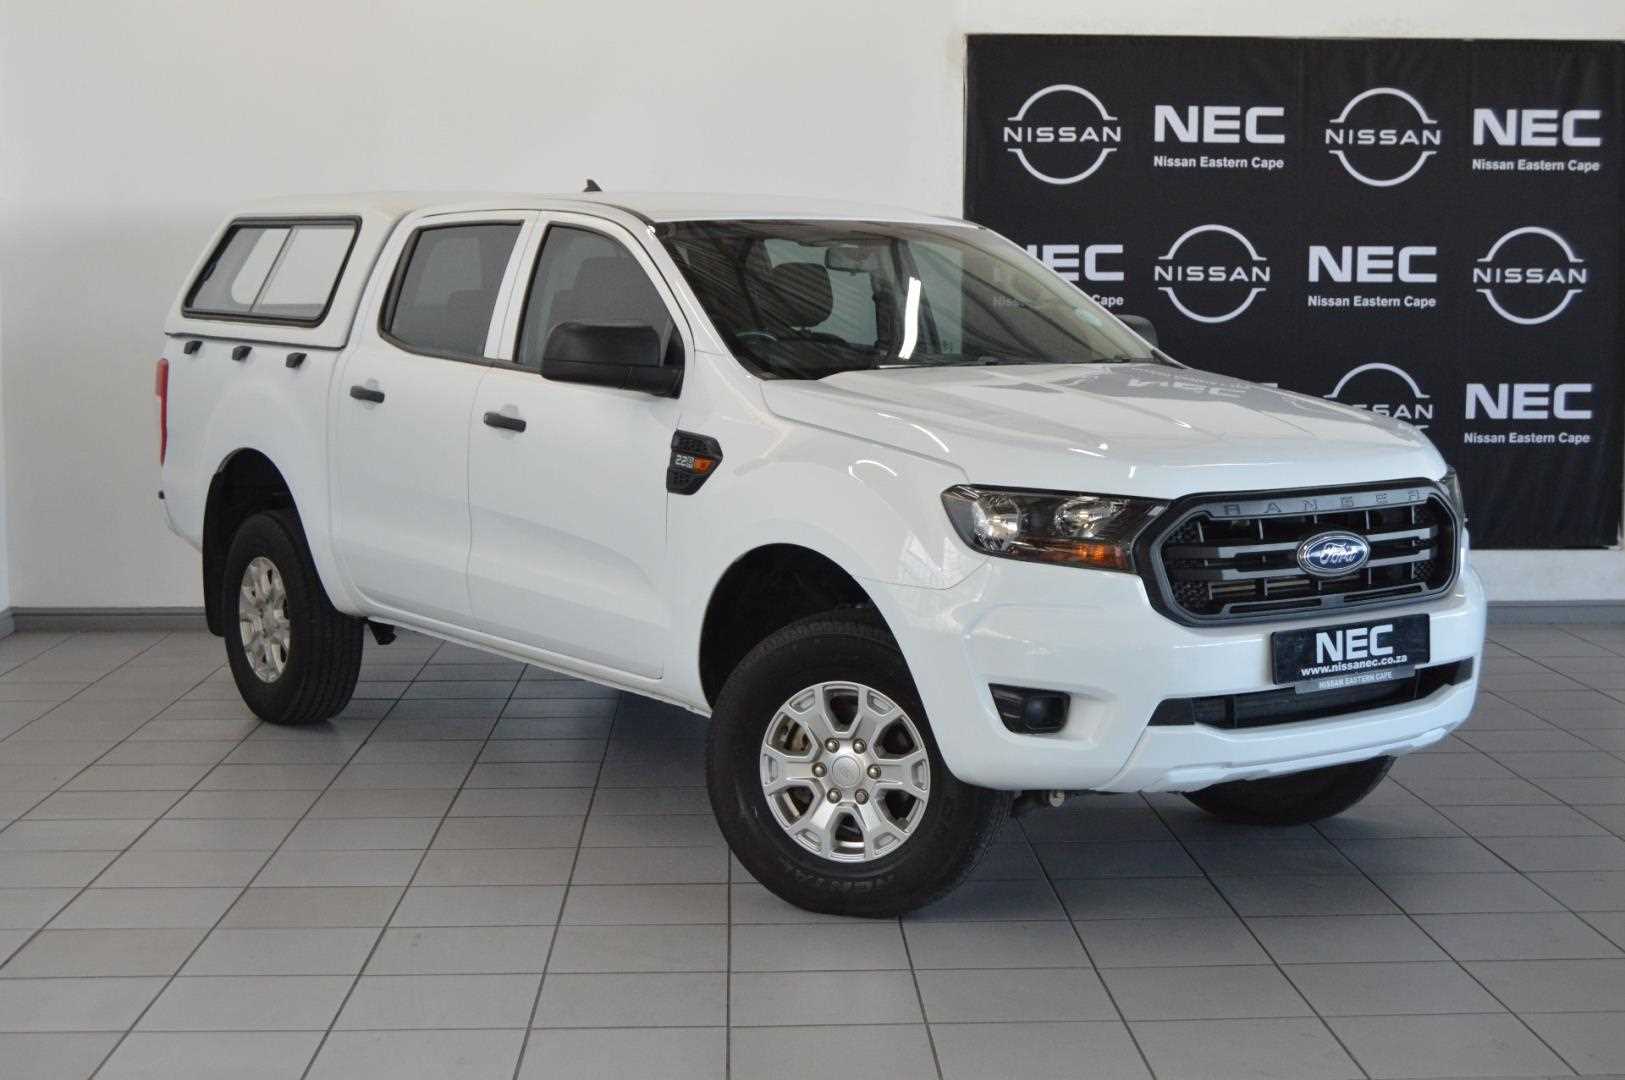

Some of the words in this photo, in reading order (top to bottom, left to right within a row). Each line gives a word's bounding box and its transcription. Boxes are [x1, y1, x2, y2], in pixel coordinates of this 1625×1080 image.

[1154, 105, 1285, 144] NEC
[1473, 108, 1602, 146] NEC
[1004, 127, 1121, 142] NISSAN
[1326, 129, 1441, 145] NISSAN
[1154, 156, 1196, 167] Nissan
[1200, 156, 1248, 168] Eastern
[1251, 157, 1284, 170] Cape
[1472, 159, 1514, 170] Nissan
[1518, 159, 1564, 170] Eastern
[1568, 160, 1600, 173] Cape
[1309, 246, 1437, 283] NEC
[1155, 266, 1270, 282] NISSAN
[1473, 268, 1587, 283] NISSAN
[1091, 294, 1124, 307] Cape
[1308, 296, 1350, 306] Nissan
[1354, 296, 1400, 307] Eastern
[1404, 296, 1436, 309] Cape
[1465, 383, 1592, 419] NEC
[1352, 404, 1433, 419] SAN
[1464, 433, 1505, 443] Nissan
[1509, 433, 1555, 443] Eastern
[1559, 432, 1590, 445] Cape
[1319, 543, 1359, 565] Ford
[1316, 624, 1393, 664] NEC
[1301, 654, 1407, 677] www.nissanec.co.za
